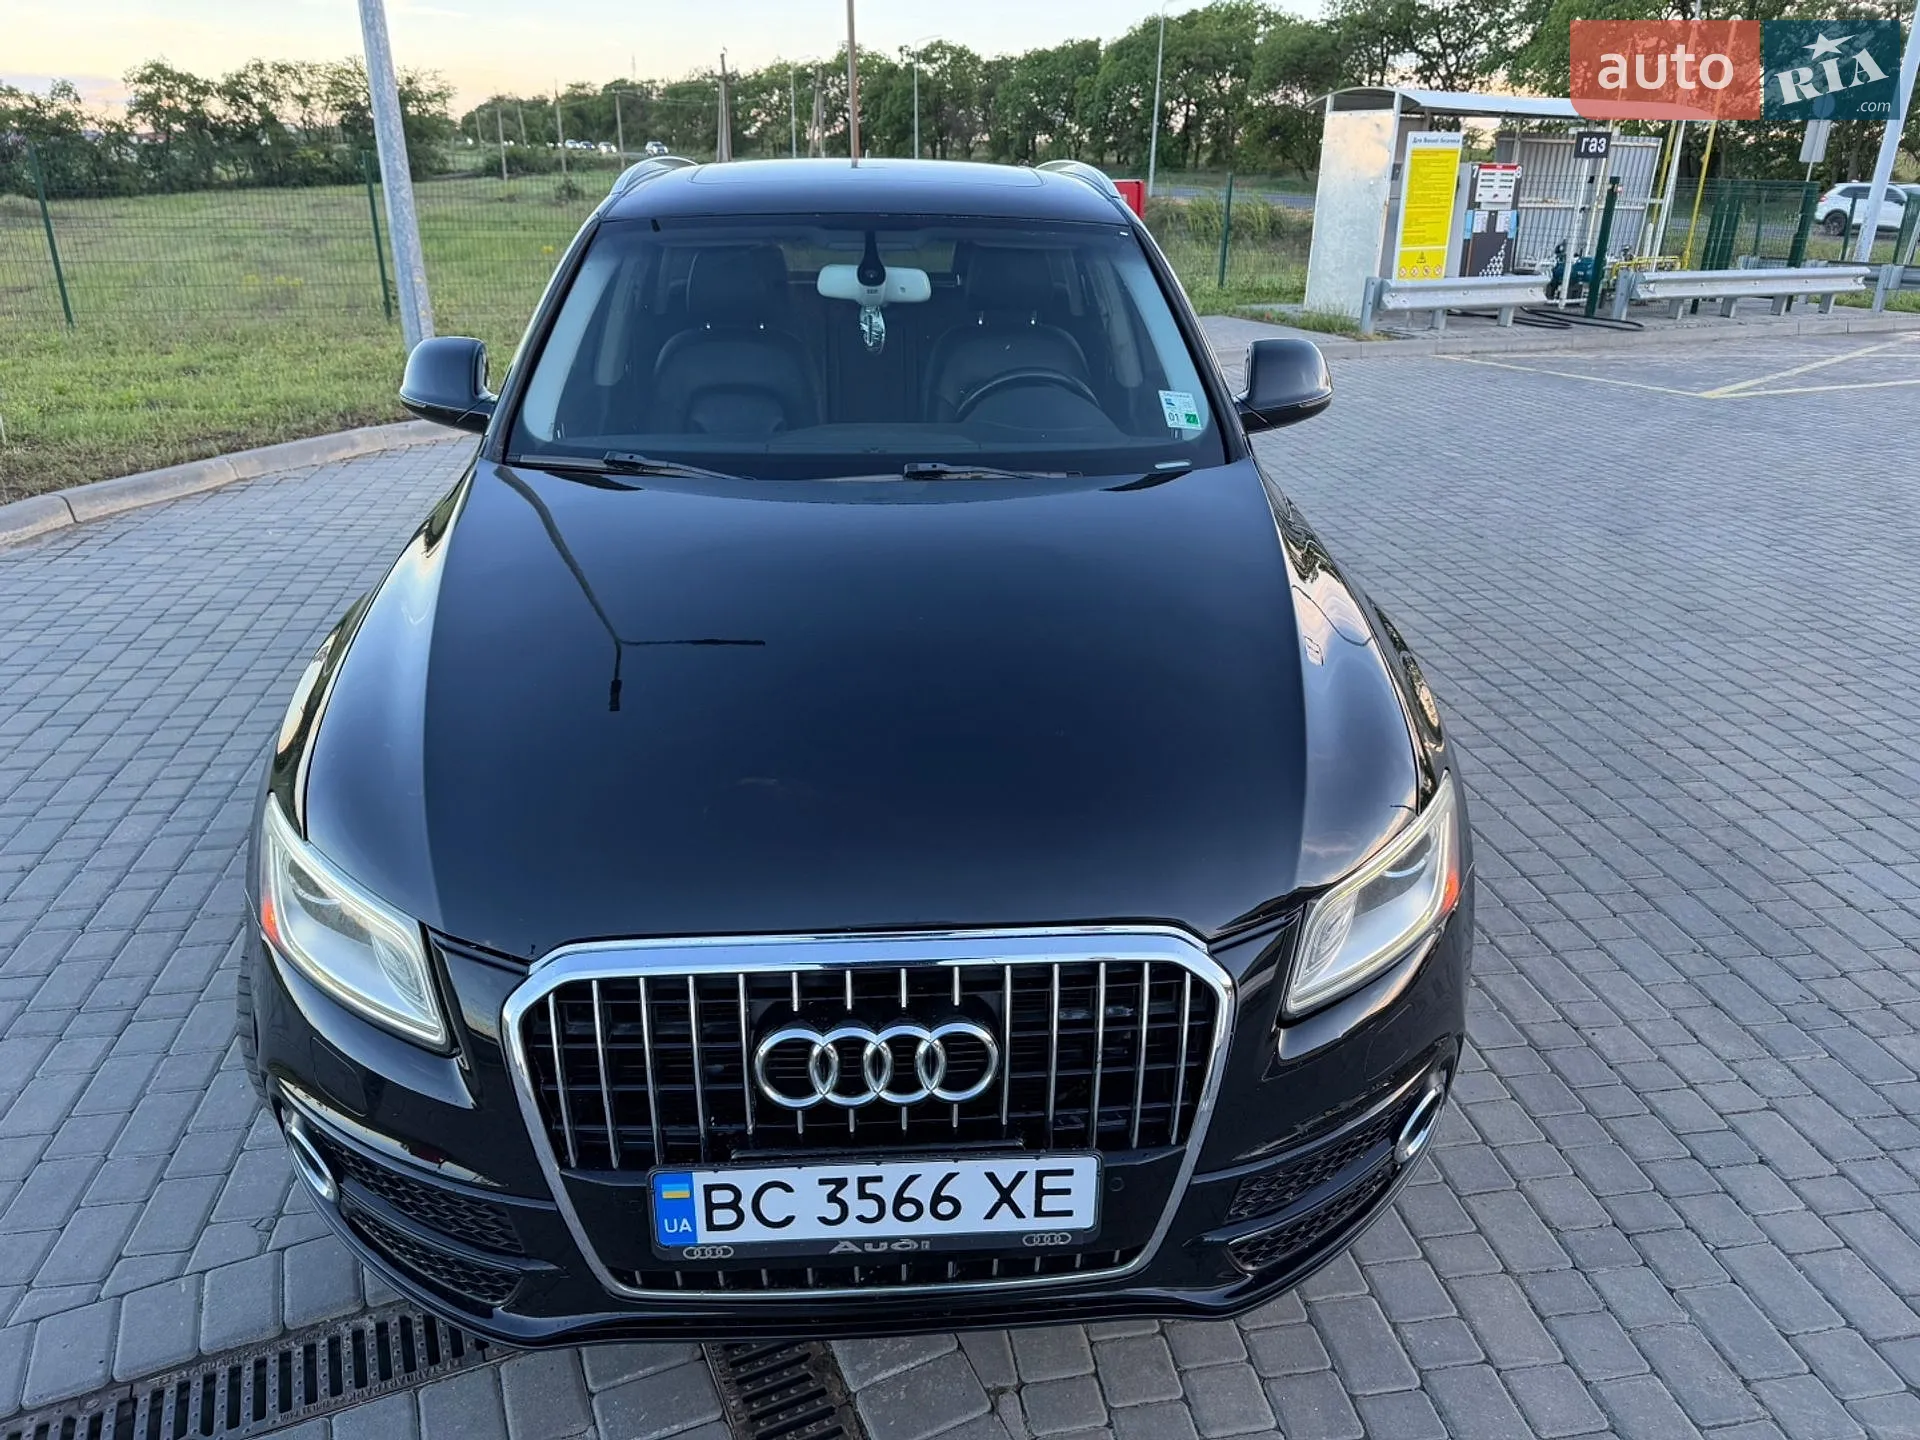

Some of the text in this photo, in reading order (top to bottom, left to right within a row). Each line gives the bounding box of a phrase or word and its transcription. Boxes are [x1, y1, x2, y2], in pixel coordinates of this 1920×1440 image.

[1472, 166, 1480, 179] 7
[816, 1171, 962, 1226] 3566
[983, 1168, 1075, 1220] XE
[664, 1218, 692, 1233] UA
